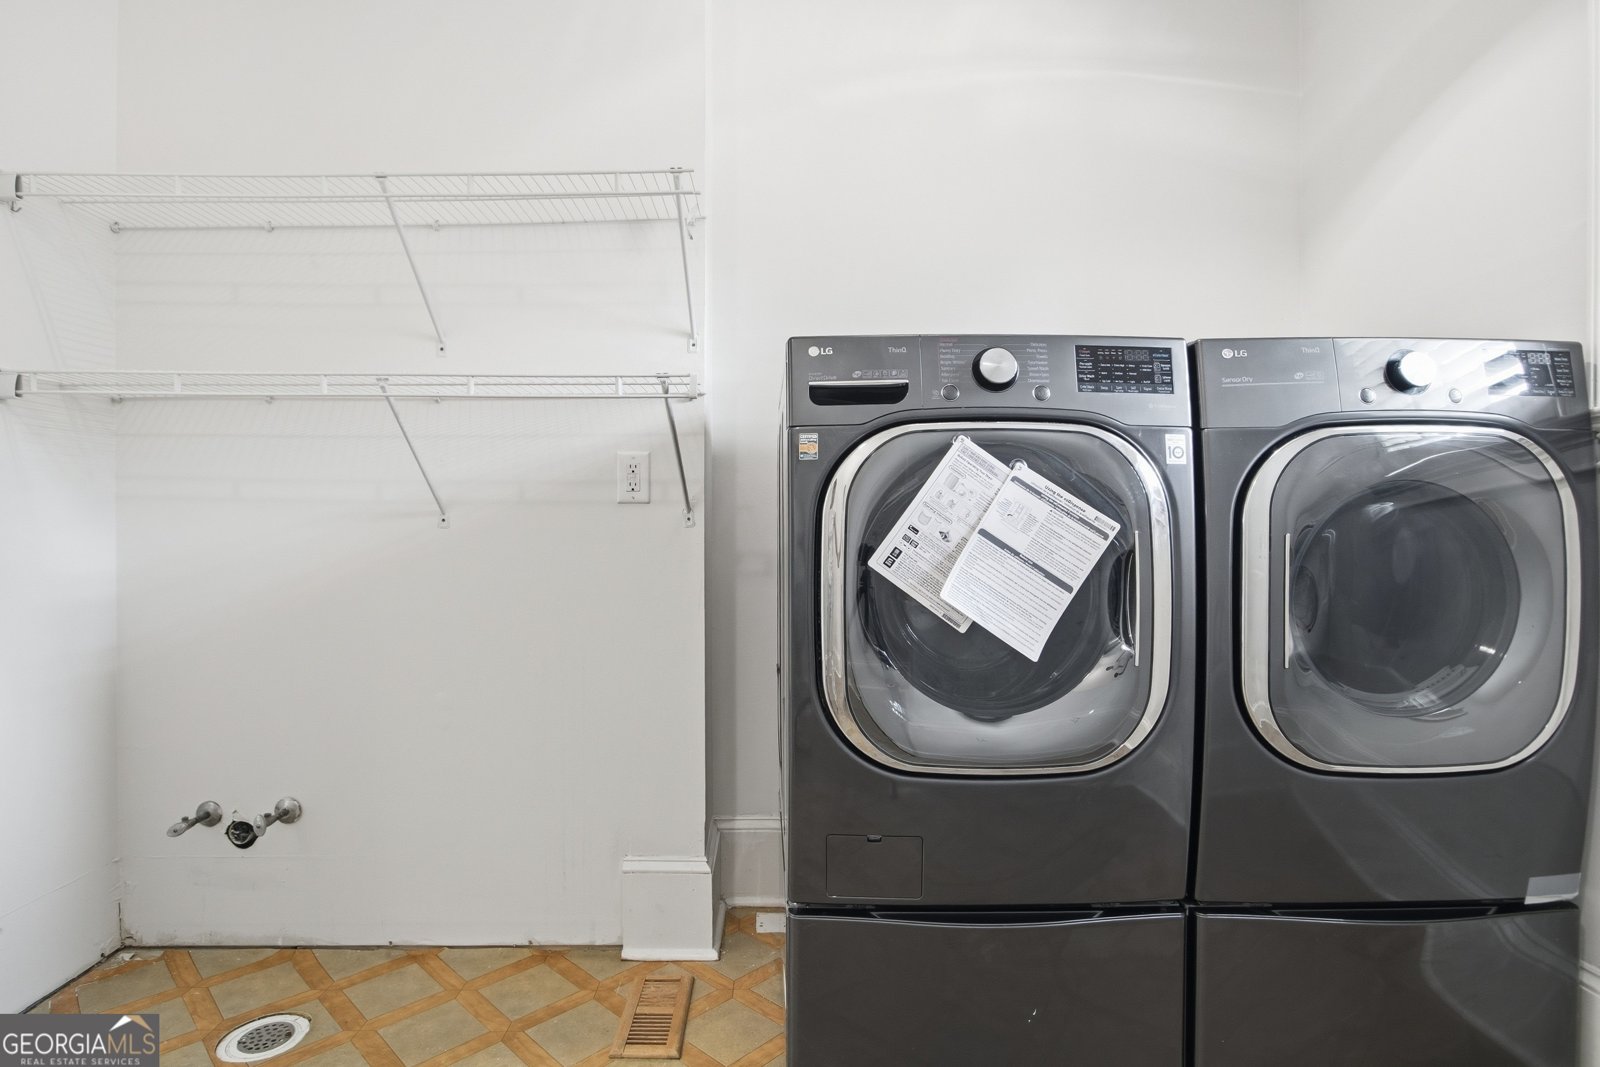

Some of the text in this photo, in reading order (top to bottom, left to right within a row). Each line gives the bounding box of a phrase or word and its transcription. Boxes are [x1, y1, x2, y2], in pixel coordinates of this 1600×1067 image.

[820, 347, 833, 355] LG
[1234, 350, 1248, 358] LG
[1168, 446, 1185, 459] 10
[1044, 484, 1057, 495] Using
